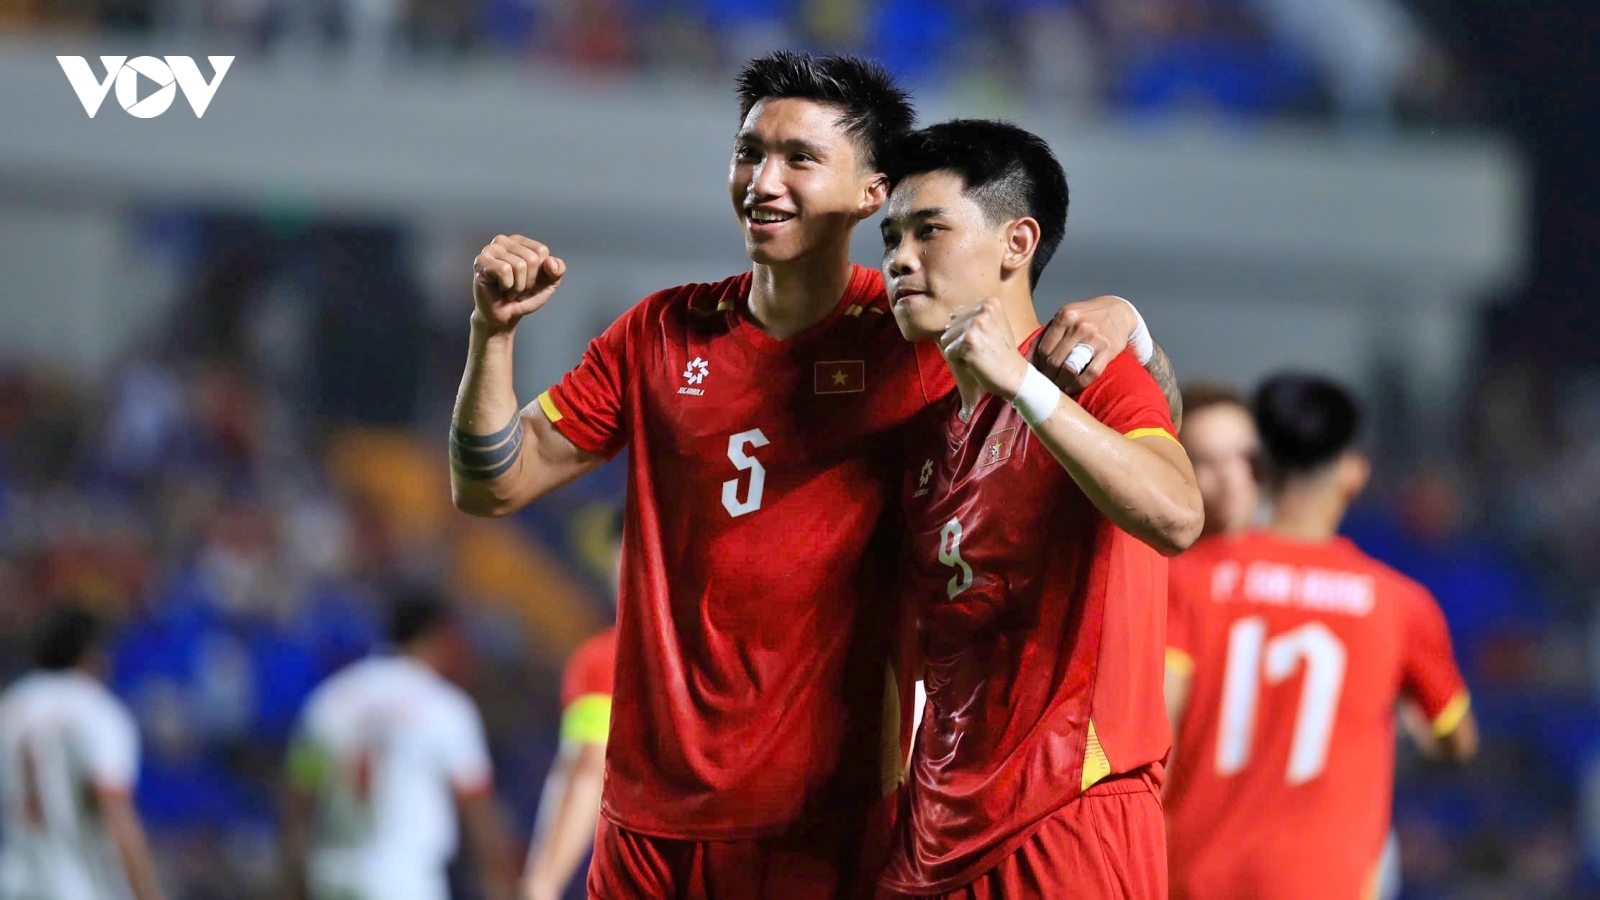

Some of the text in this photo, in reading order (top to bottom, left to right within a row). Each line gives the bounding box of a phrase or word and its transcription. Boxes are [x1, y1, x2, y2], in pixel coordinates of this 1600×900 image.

[721, 428, 771, 518] 5
[938, 516, 973, 600] 9
[1214, 616, 1347, 786] 17
